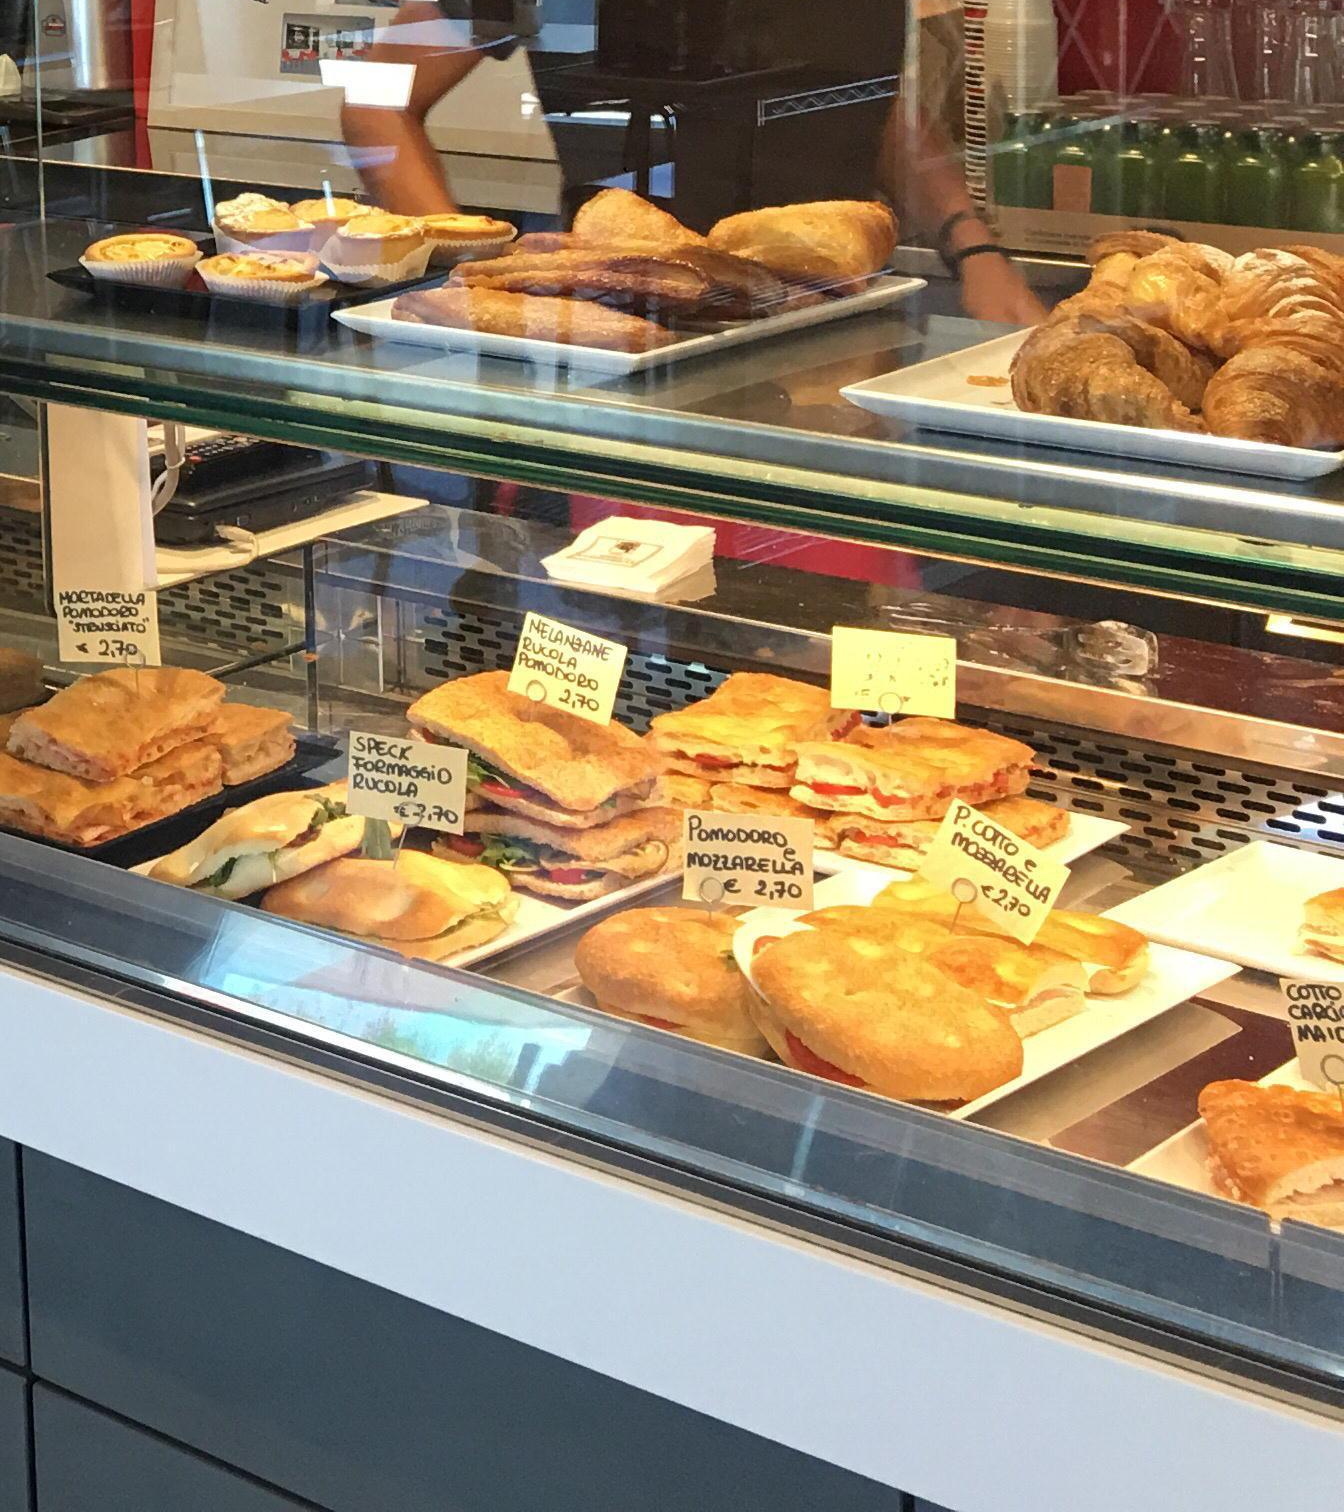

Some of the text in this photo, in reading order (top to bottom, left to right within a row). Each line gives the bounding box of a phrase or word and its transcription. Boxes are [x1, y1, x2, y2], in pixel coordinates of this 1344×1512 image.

[59, 590, 145, 605] MORTADELLA
[63, 606, 139, 619] POMODORO
[98, 640, 138, 658] 2,70
[522, 637, 577, 670] RUCOLA
[518, 652, 599, 691] POMODORO
[558, 689, 600, 712] 2,70
[354, 736, 413, 761] SPECK
[353, 773, 418, 798] RUCOLA
[687, 851, 804, 876] MOZZARELLA
[783, 847, 796, 862] e
[754, 879, 803, 900] 2,70
[1286, 983, 1342, 1001] COTTO
